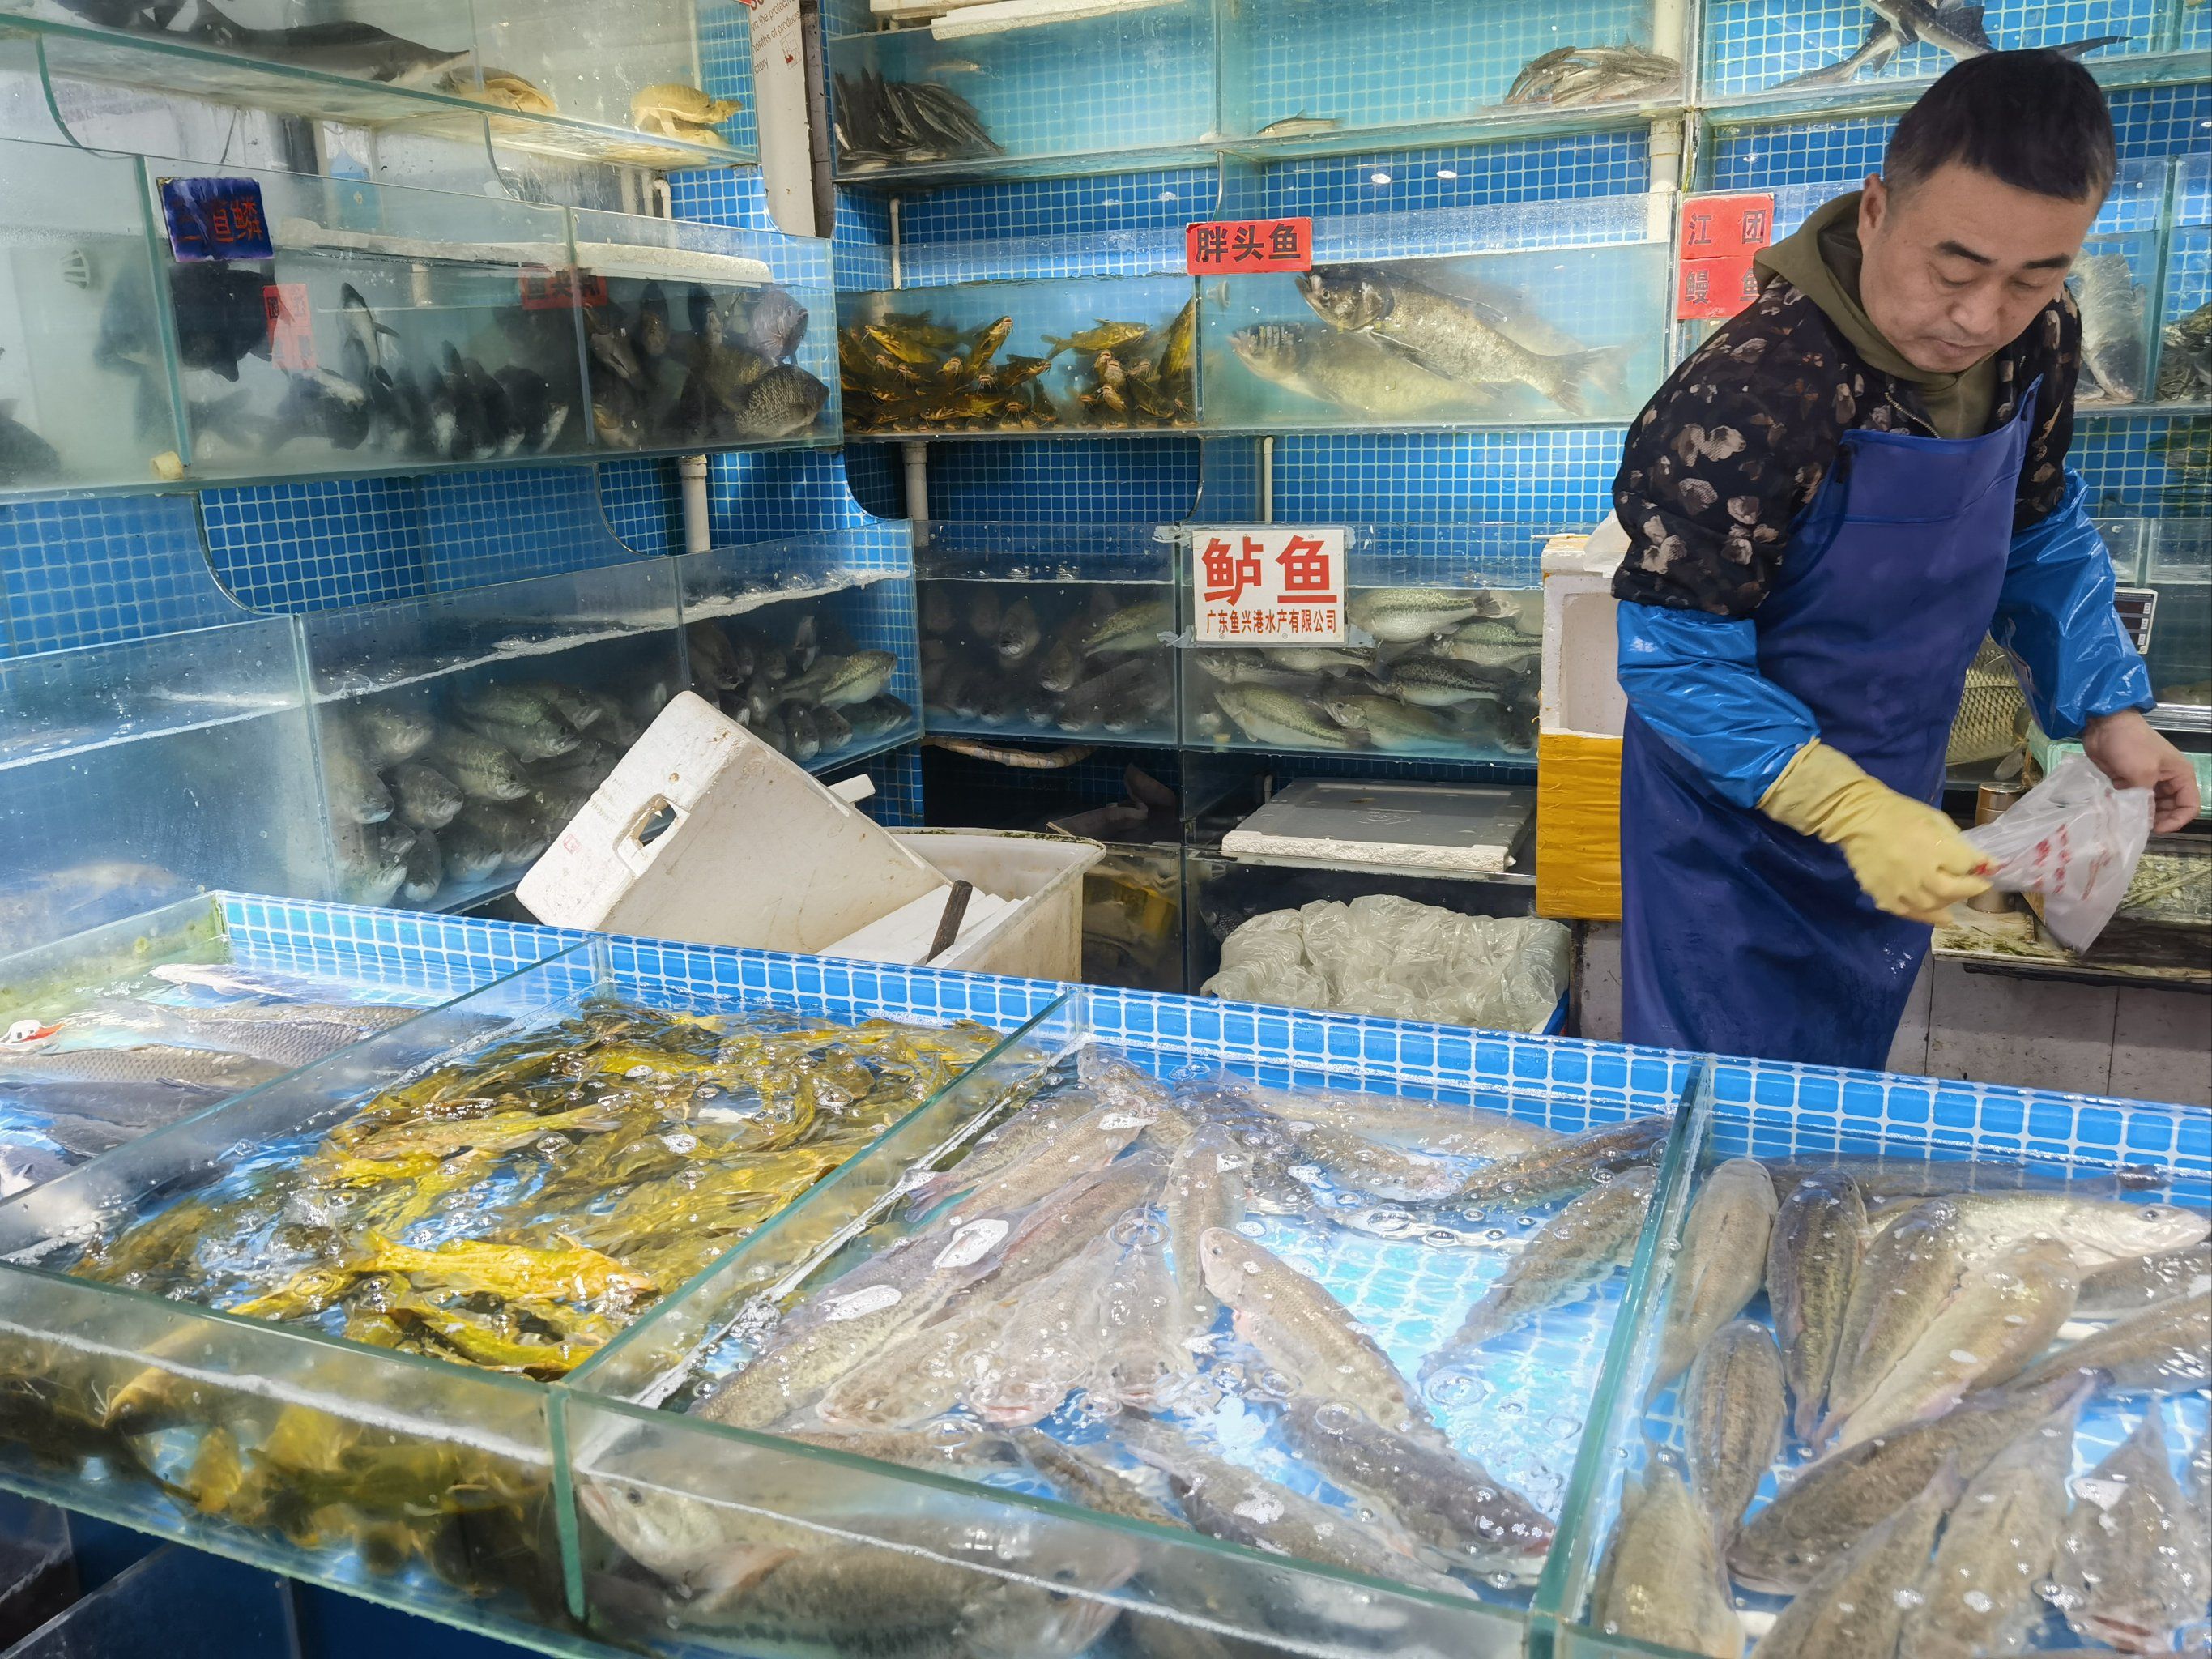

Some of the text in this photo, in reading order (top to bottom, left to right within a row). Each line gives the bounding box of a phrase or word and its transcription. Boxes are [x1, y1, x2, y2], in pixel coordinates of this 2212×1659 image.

[1195, 223, 1301, 263] 胖头鱼
[1688, 209, 1766, 246] 江团
[1201, 535, 1337, 606] 鲈鱼
[1206, 609, 1336, 634] 广东鱼兴港水产有限公司
